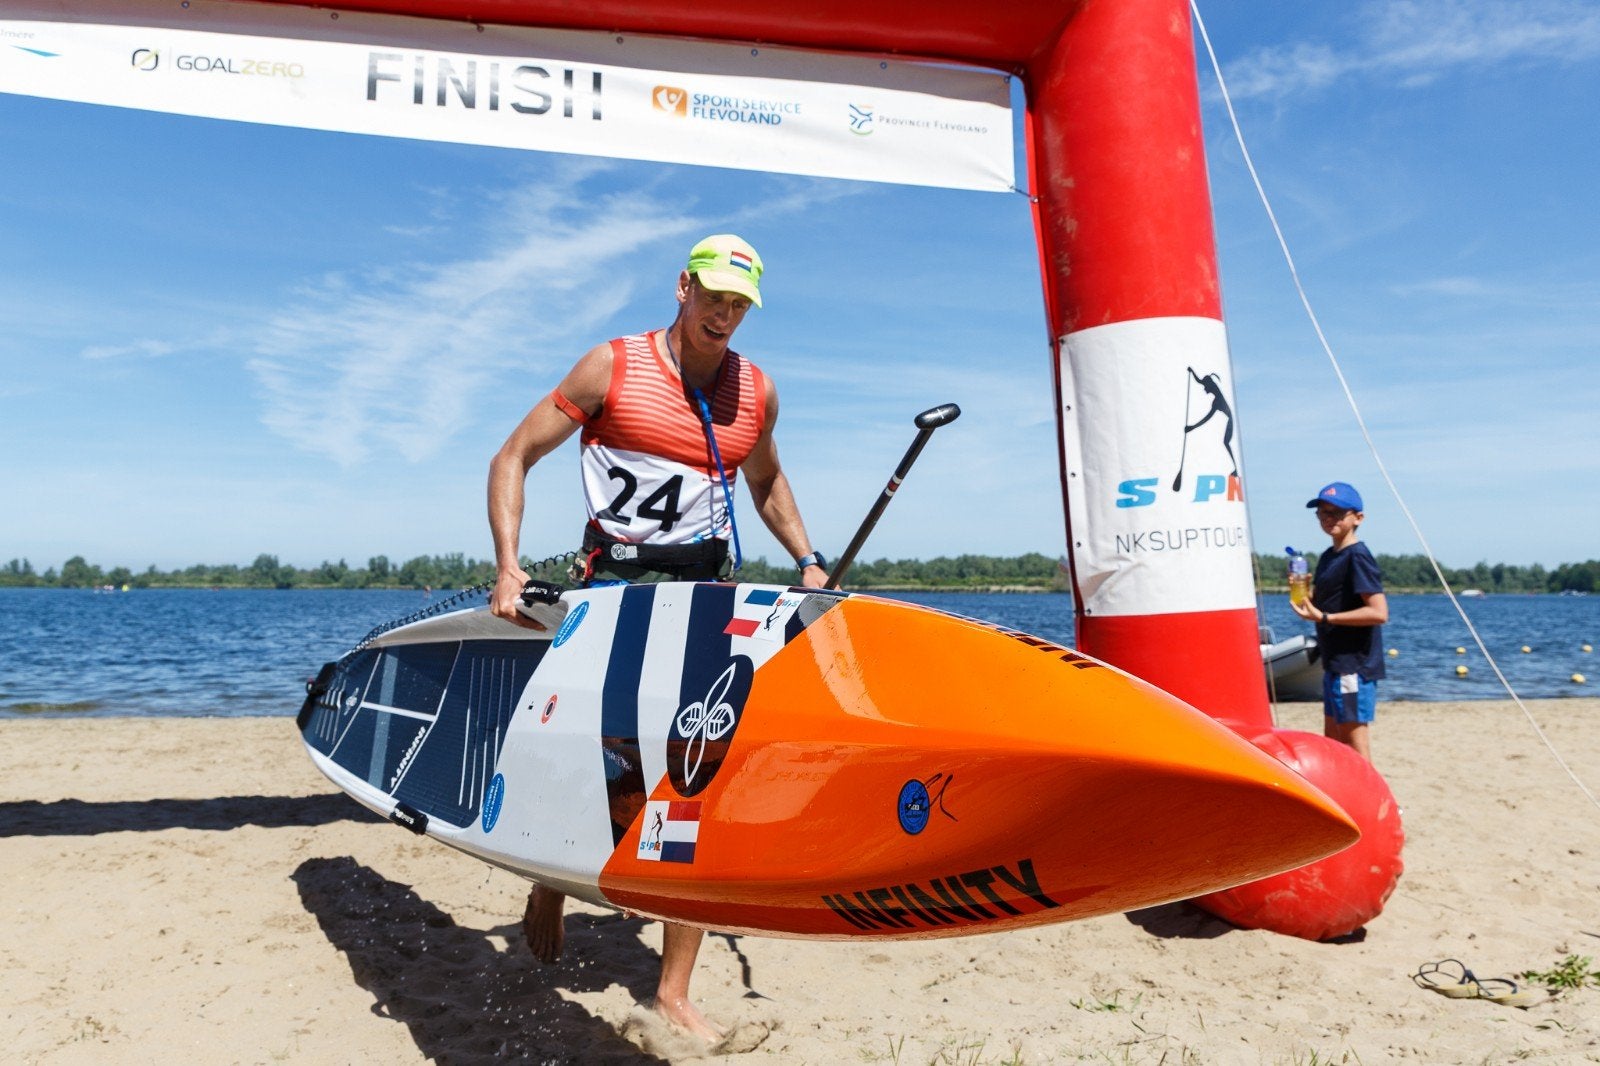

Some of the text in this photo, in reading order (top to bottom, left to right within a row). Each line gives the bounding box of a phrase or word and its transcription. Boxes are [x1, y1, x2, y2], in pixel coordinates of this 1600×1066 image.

[367, 52, 602, 121] FINISH
[693, 93, 801, 114] SPORTSERVICE
[693, 108, 781, 126] FLEVOLAND
[596, 466, 683, 532] 24
[390, 725, 427, 788] INFINITY
[821, 858, 1061, 930] INFINITY
